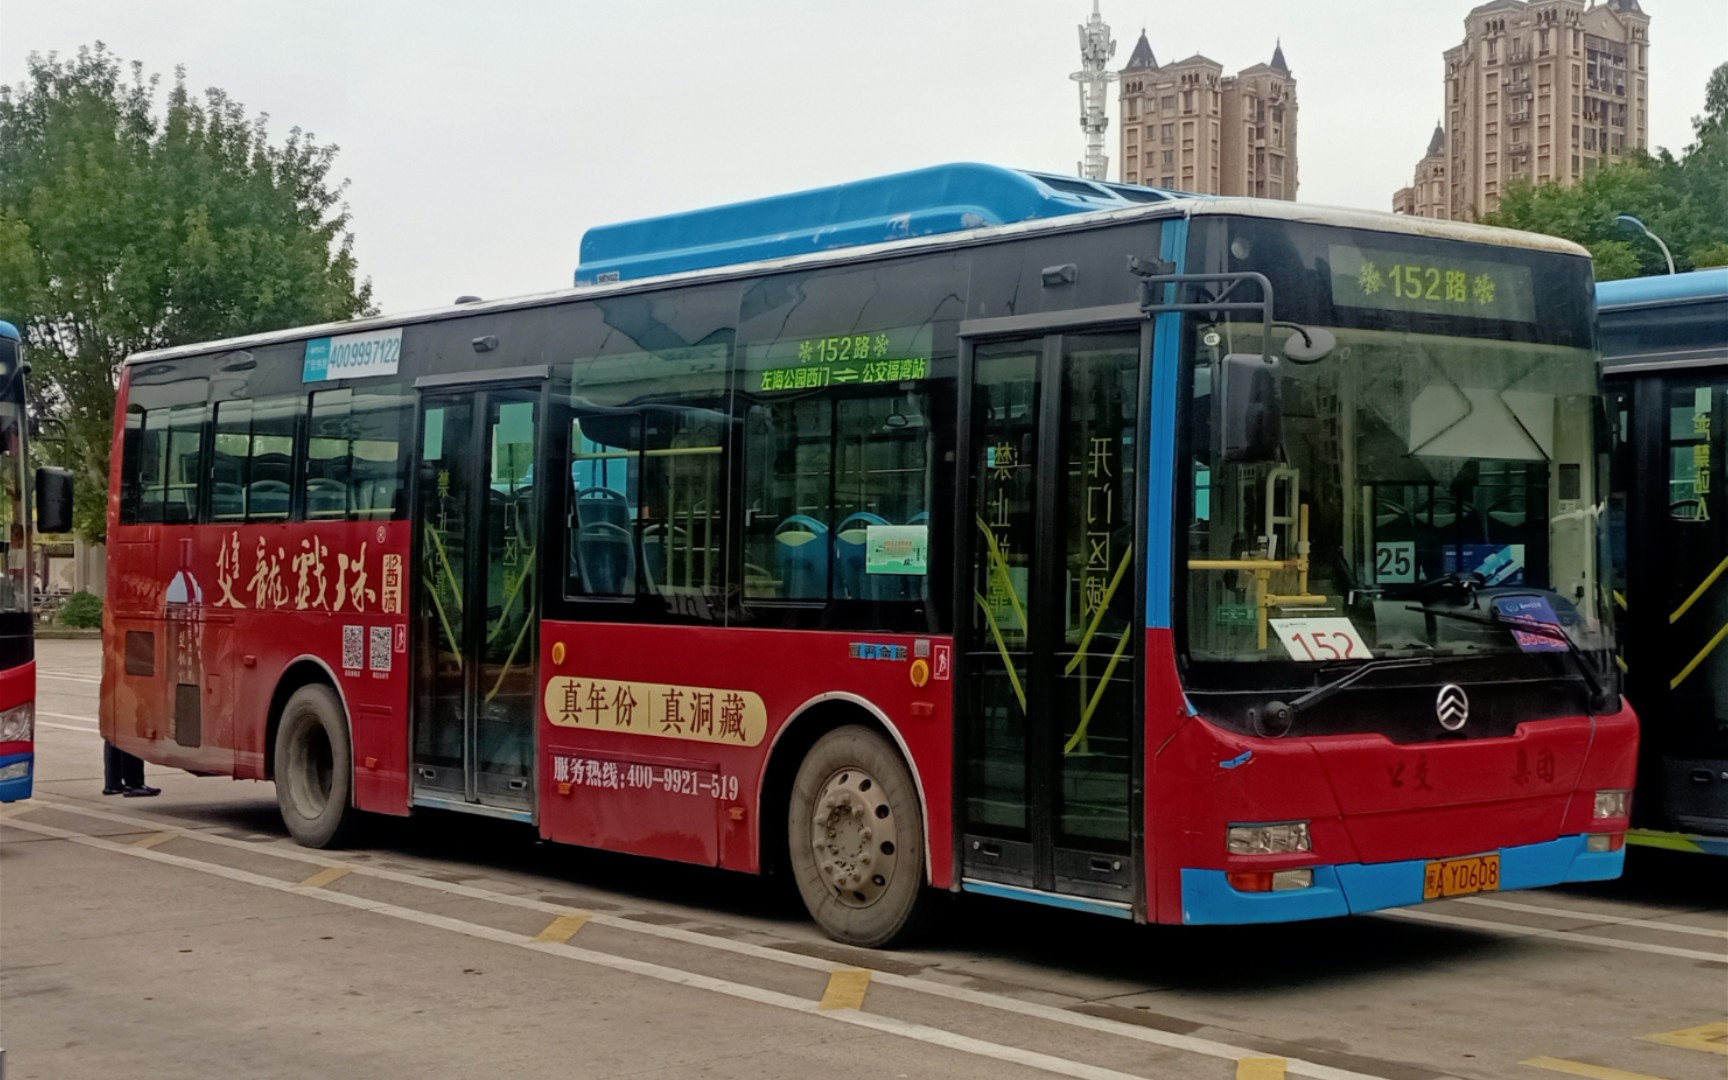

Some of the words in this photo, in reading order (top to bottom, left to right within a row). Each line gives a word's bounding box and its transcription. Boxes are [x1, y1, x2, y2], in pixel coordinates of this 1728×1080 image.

[1388, 264, 1466, 303] 152路
[329, 338, 400, 368] 4009997122
[818, 335, 870, 362] 152路
[761, 366, 830, 391] 左海公园西门
[862, 358, 926, 383] 公交福湾站
[1377, 547, 1411, 576] 25
[1291, 631, 1354, 660] 152
[559, 679, 637, 727] 真年份
[660, 688, 747, 742] 真洞藏
